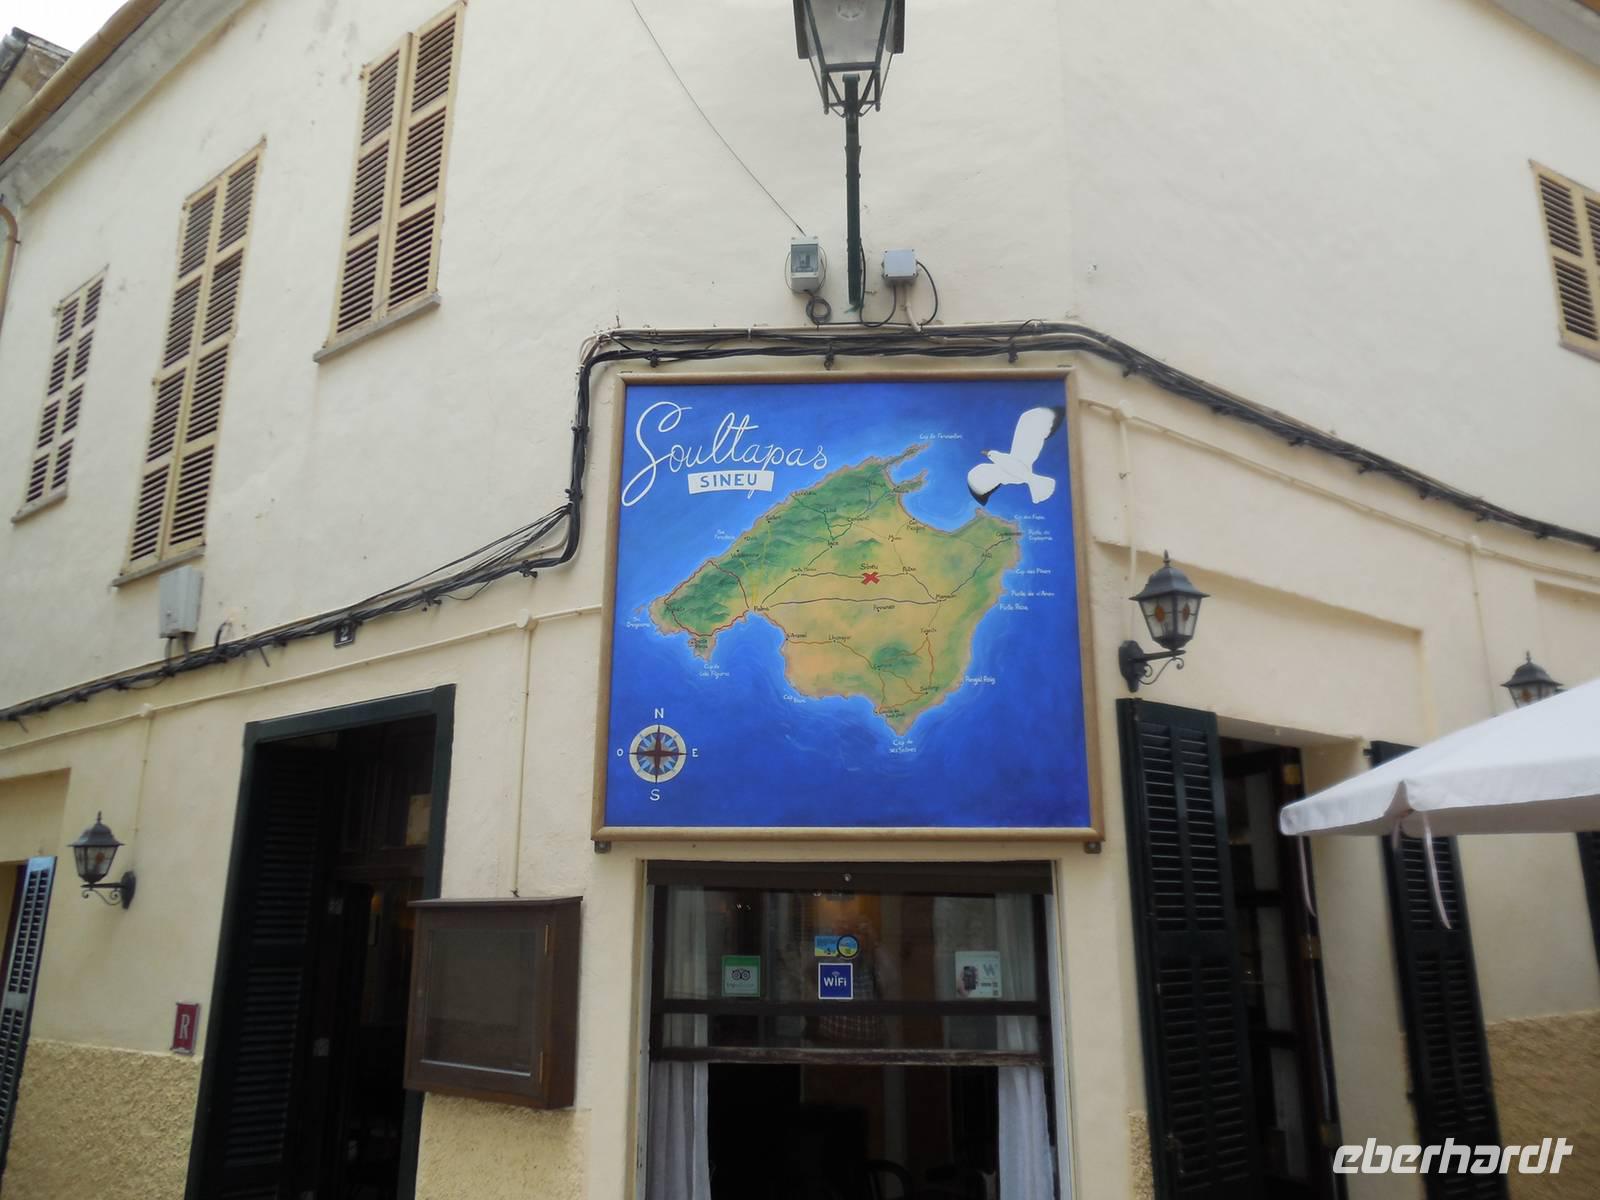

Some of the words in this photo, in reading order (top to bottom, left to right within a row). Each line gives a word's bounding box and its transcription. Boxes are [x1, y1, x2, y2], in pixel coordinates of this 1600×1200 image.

[621, 401, 828, 506] Soultapas
[700, 473, 757, 488] SINEU
[654, 707, 665, 719] N
[616, 748, 624, 757] O
[691, 748, 699, 758] E
[649, 788, 660, 801] S
[179, 1014, 189, 1039] R
